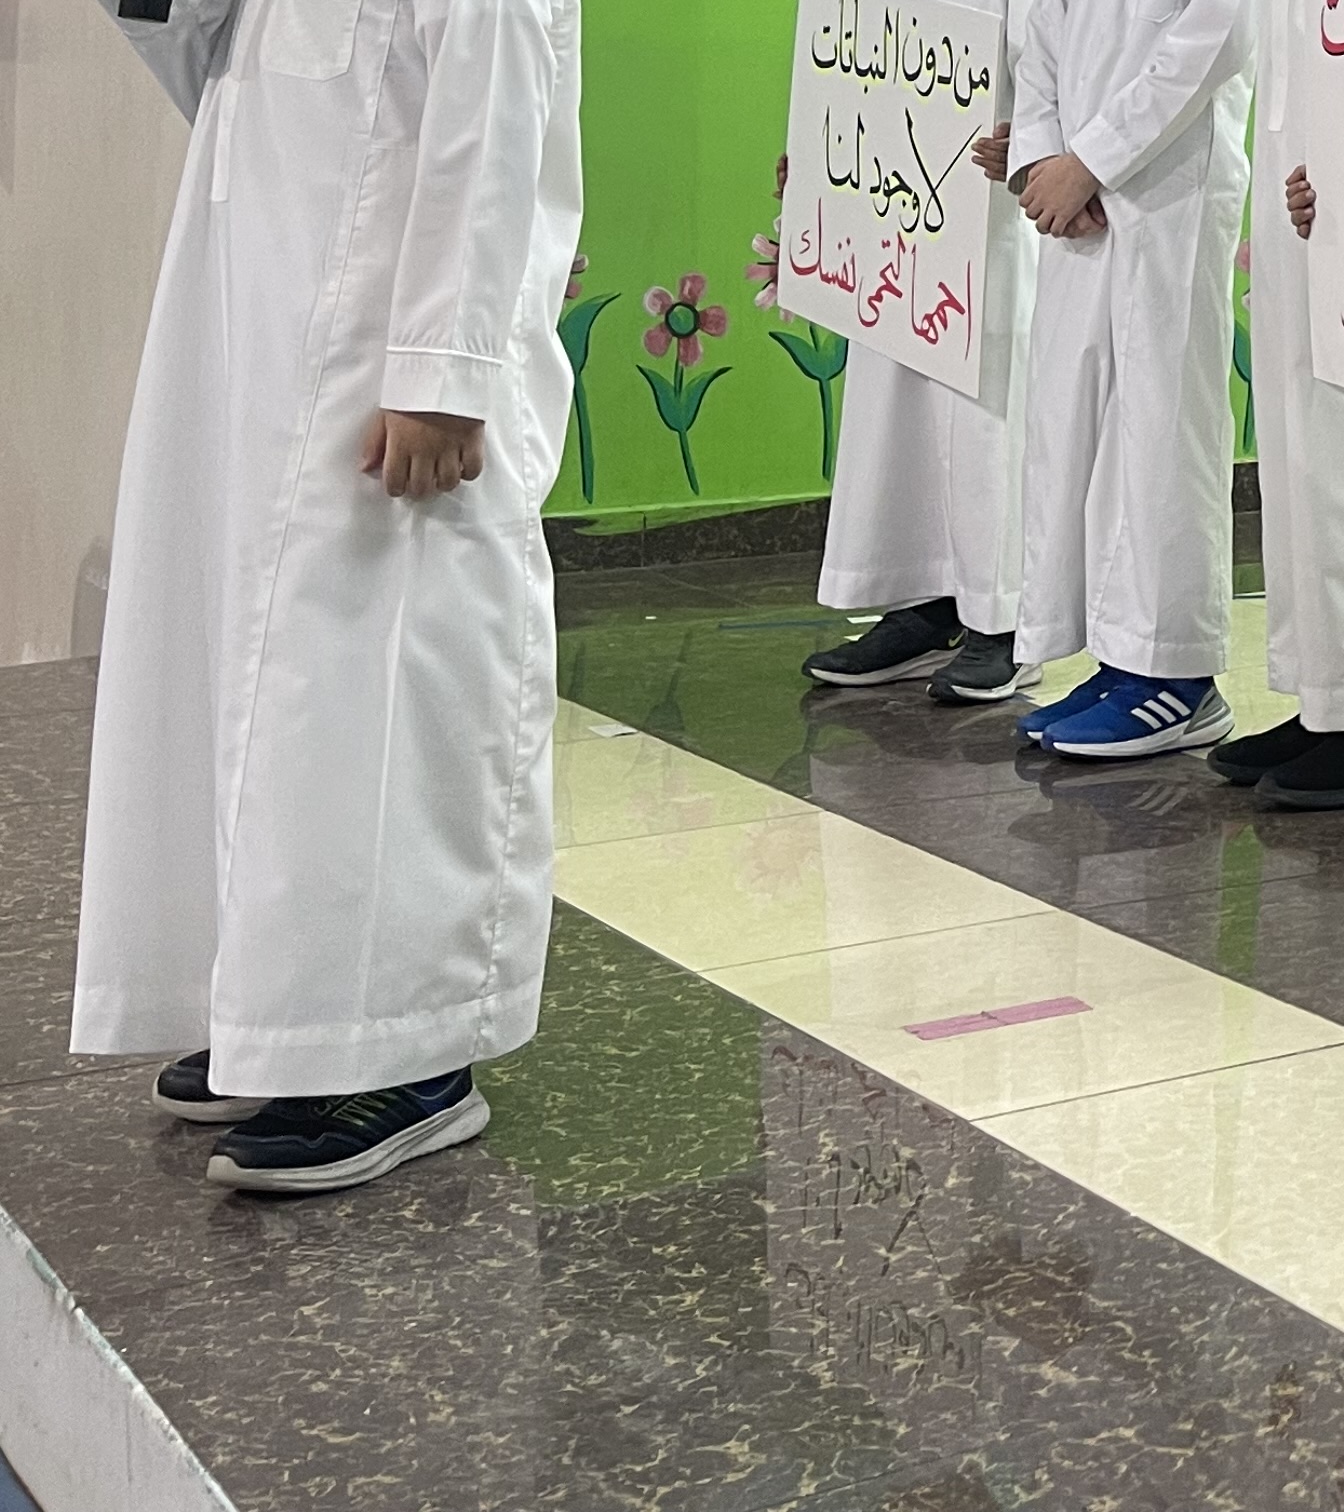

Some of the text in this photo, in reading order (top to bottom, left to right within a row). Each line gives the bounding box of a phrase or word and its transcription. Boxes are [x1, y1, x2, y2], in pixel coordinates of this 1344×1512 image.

[901, 16, 954, 97] دون
[953, 44, 991, 108] من
[821, 105, 983, 233] لا وجود لنا
[788, 196, 857, 294] نفسك
